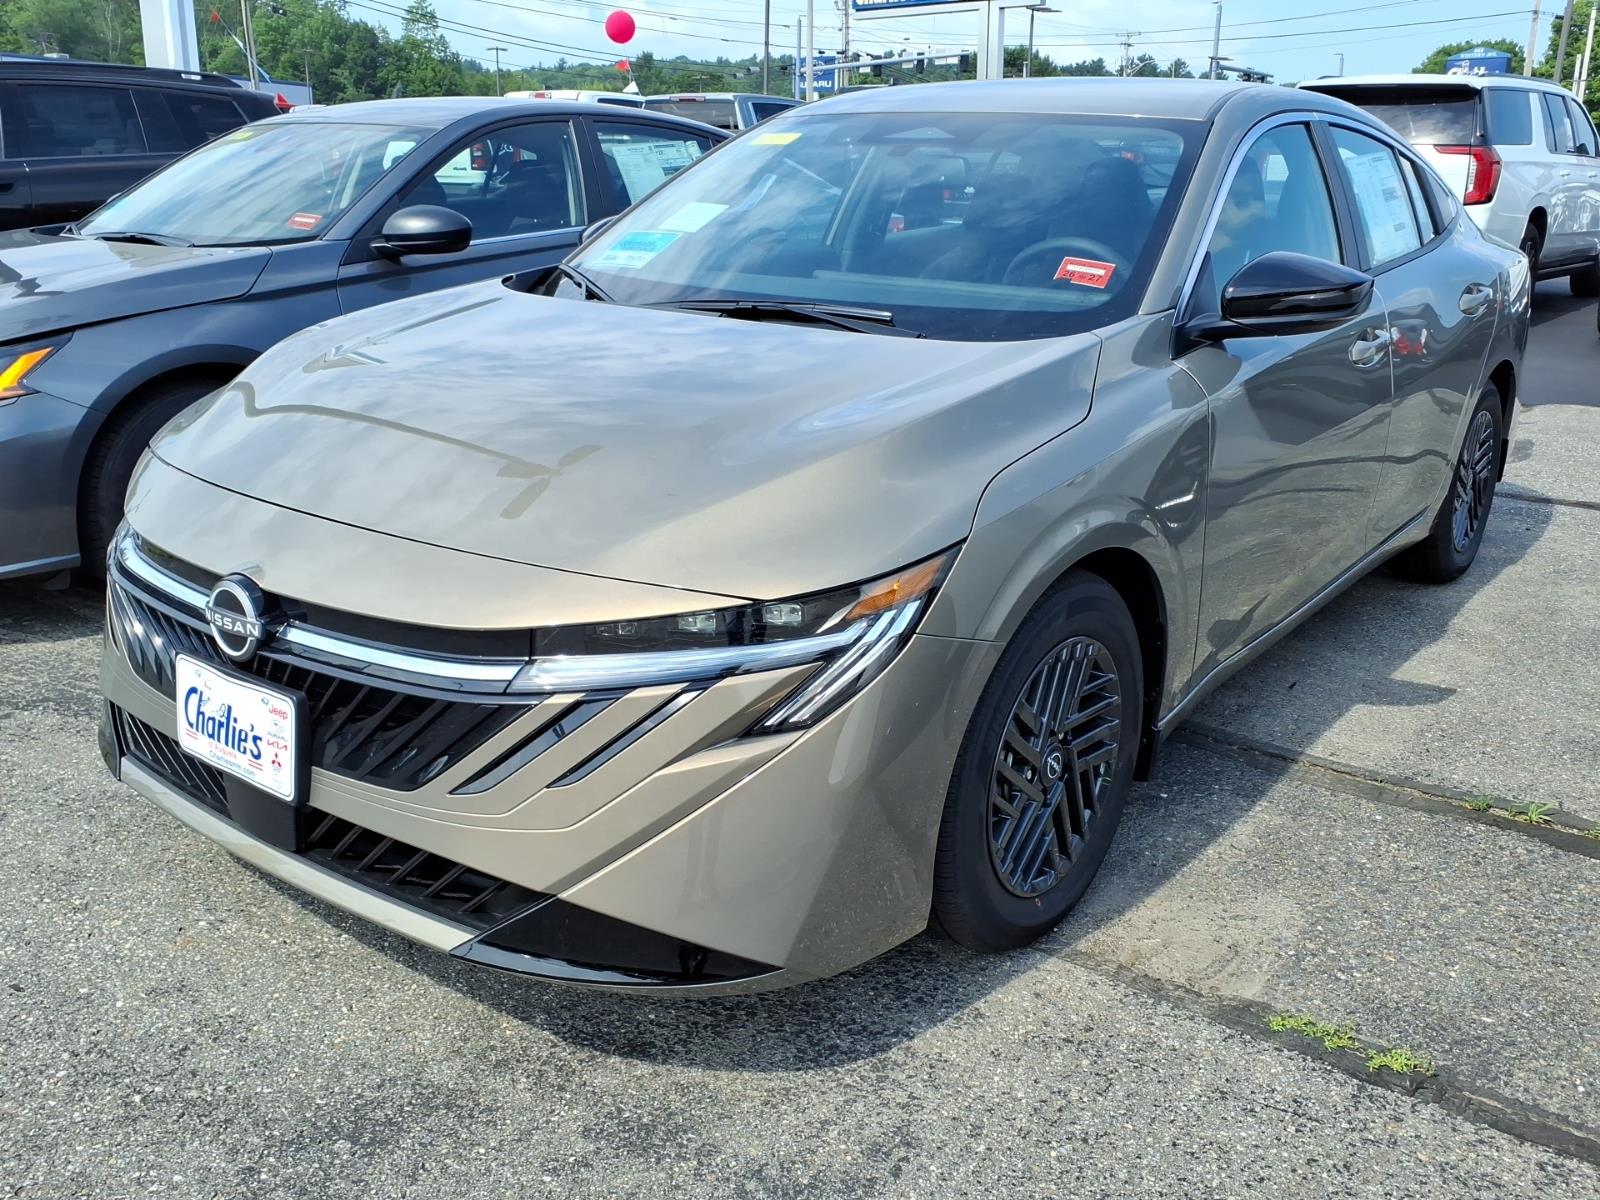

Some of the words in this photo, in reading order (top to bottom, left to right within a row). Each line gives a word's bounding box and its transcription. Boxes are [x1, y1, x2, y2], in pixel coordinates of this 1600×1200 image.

[1088, 274, 1103, 282] 27
[206, 609, 258, 635] NISSAN
[269, 705, 288, 720] Jeep
[185, 686, 263, 760] Charlie's
[267, 739, 288, 751] KIA
